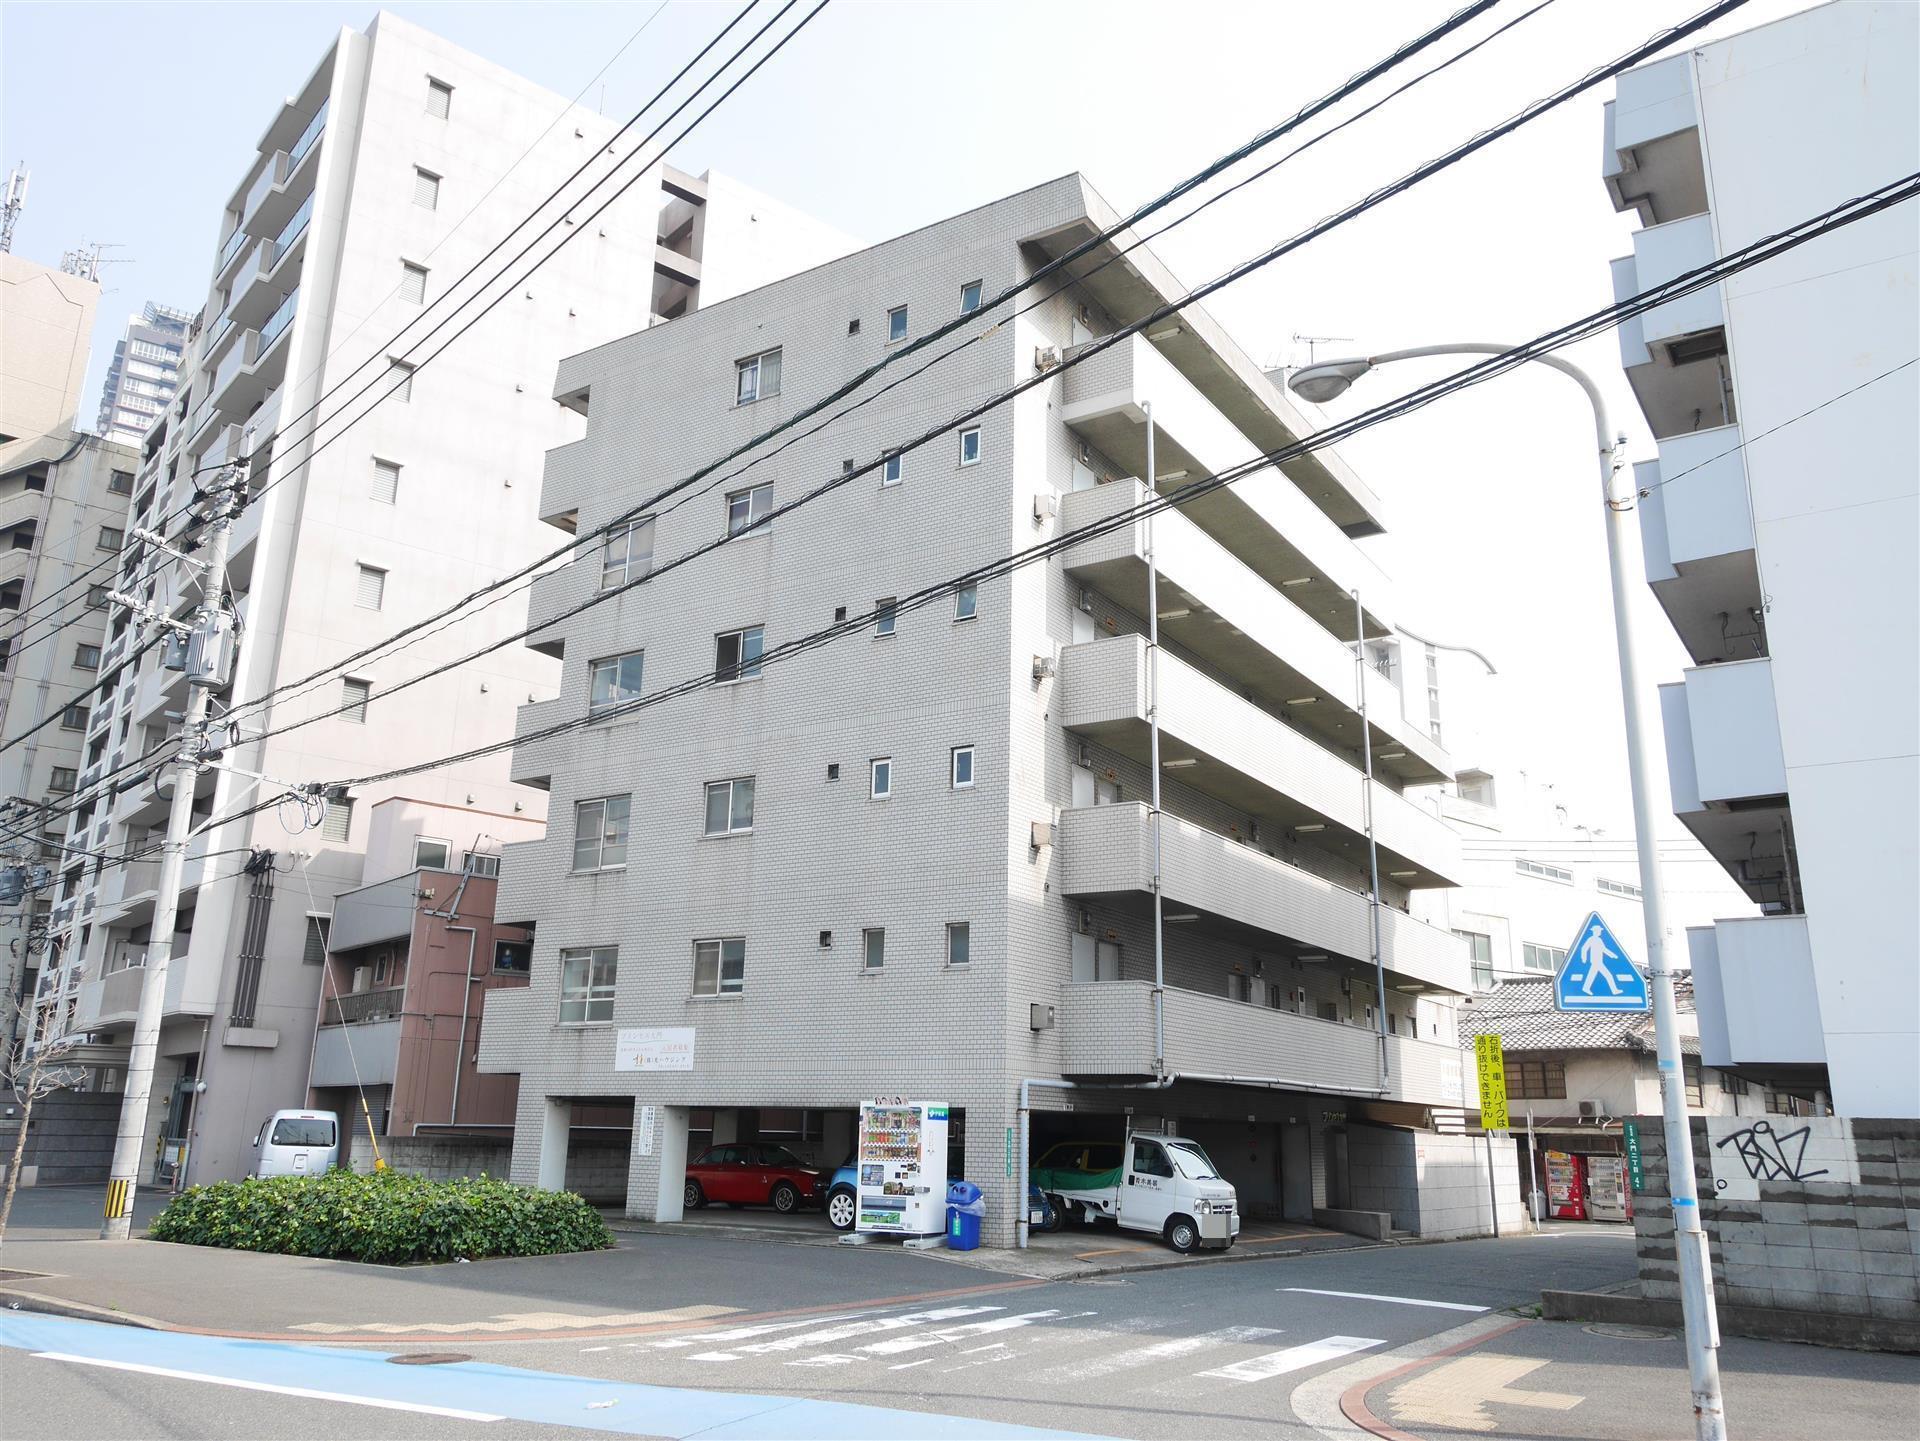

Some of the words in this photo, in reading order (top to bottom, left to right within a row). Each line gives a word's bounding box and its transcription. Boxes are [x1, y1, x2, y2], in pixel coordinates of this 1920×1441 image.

[1477, 1036, 1493, 1118] 通り抜けできません
[1489, 1036, 1506, 1127] 右折後、車・バイクは
[1629, 1138, 1639, 1173] 大門二丁目
